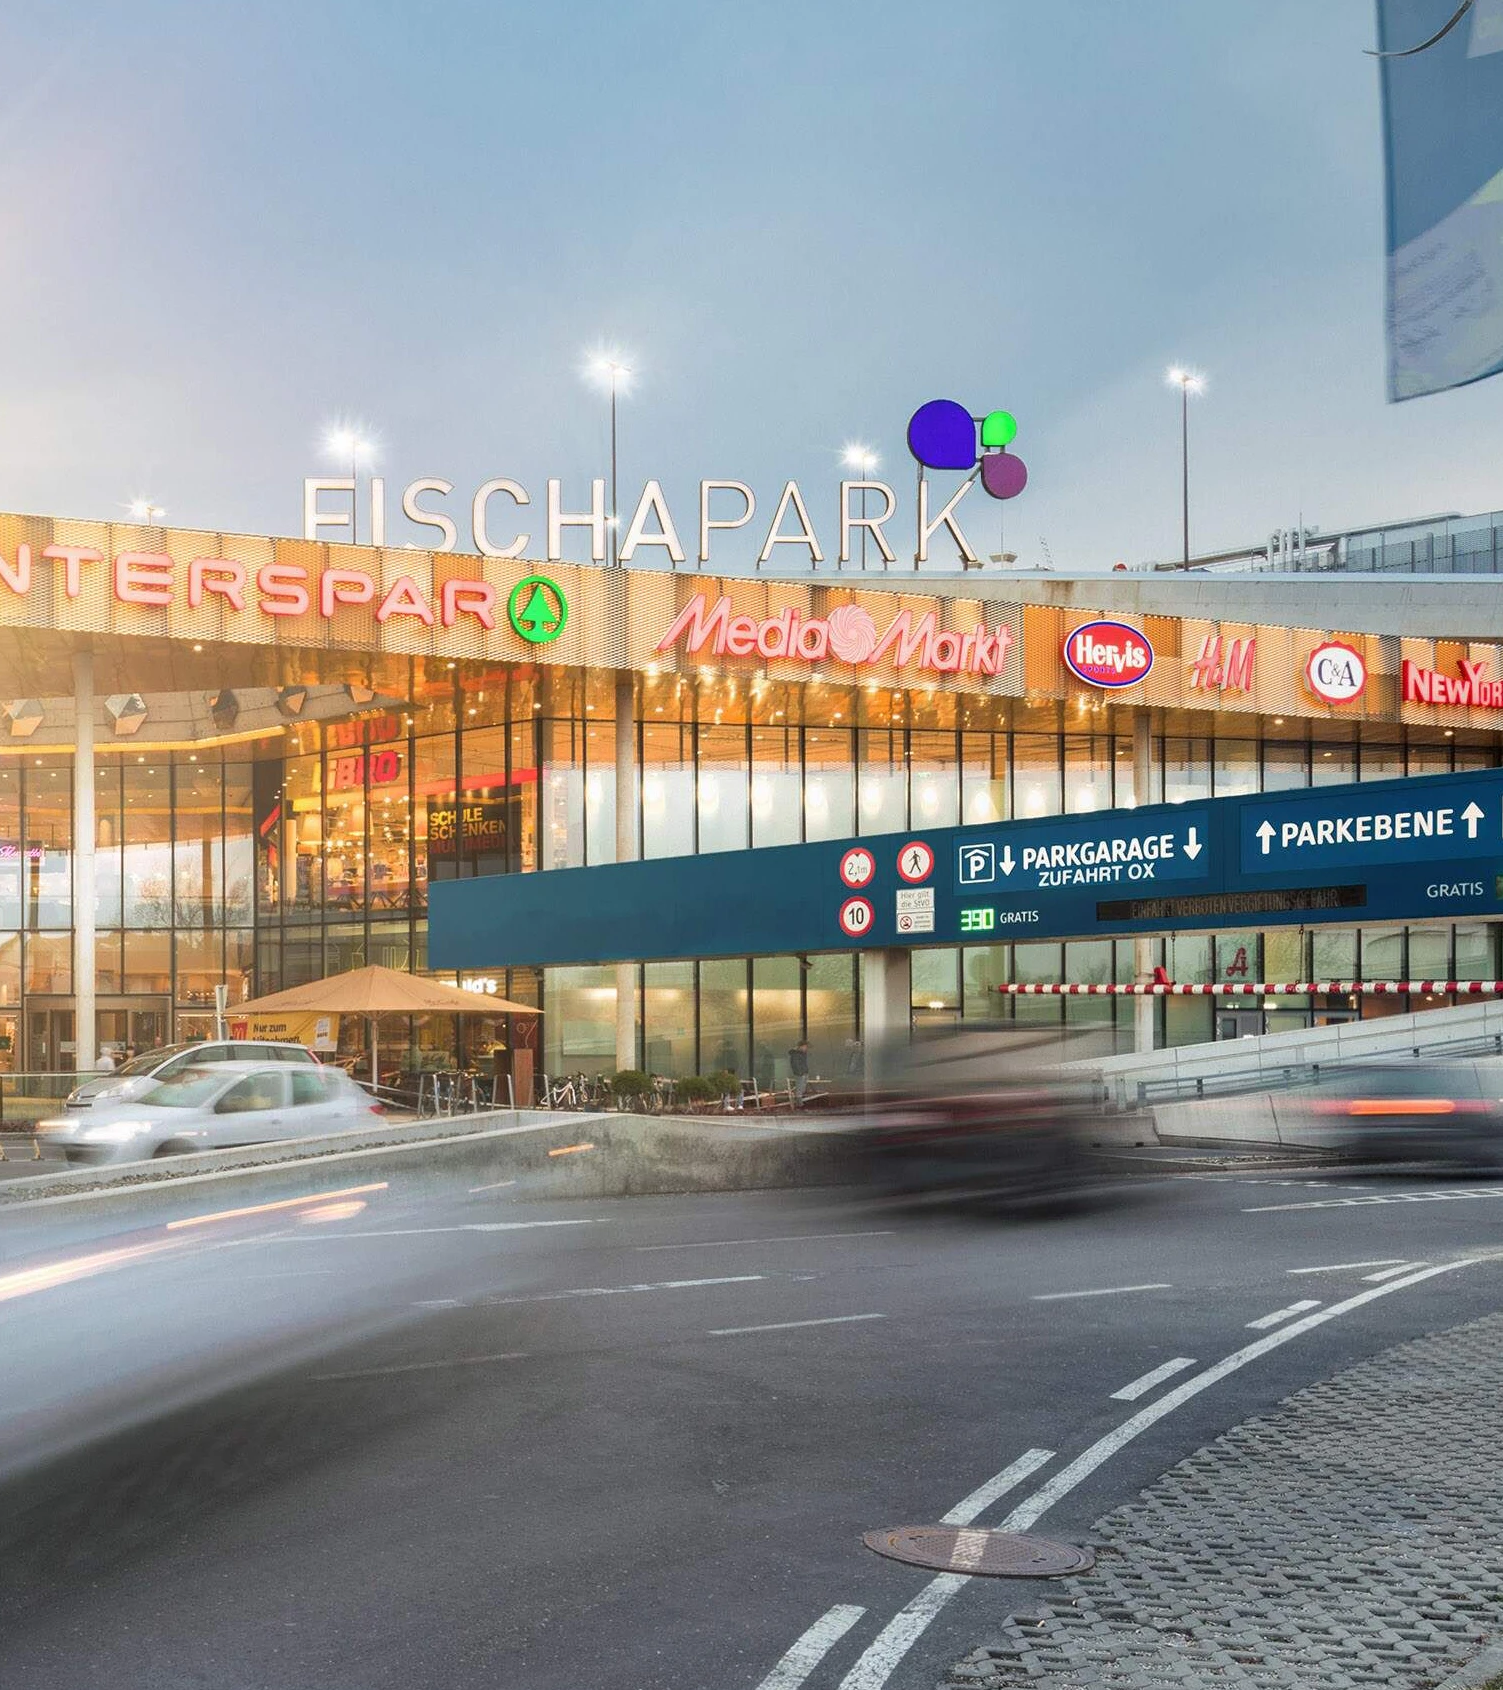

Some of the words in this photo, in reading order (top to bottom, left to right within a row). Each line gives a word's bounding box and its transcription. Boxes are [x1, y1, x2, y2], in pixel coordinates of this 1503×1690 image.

[302, 477, 980, 562] FISCHAPARK
[656, 593, 829, 661] Media
[868, 609, 1012, 675] Markt
[1076, 634, 1146, 673] Hervis
[1191, 636, 1256, 692] H&M
[1318, 658, 1357, 687] C&A
[1282, 808, 1454, 848] PARKEBENE
[1022, 834, 1175, 870] PARKGARAGE
[1038, 865, 1123, 887] ZUFAHRT
[1128, 863, 1155, 880] OX
[1427, 881, 1484, 898] GRATIS
[848, 907, 864, 925] 10
[961, 908, 994, 931] 390
[1000, 910, 1039, 924] GRATIS
[253, 1022, 267, 1033] Nur
[269, 1022, 287, 1032] zum
